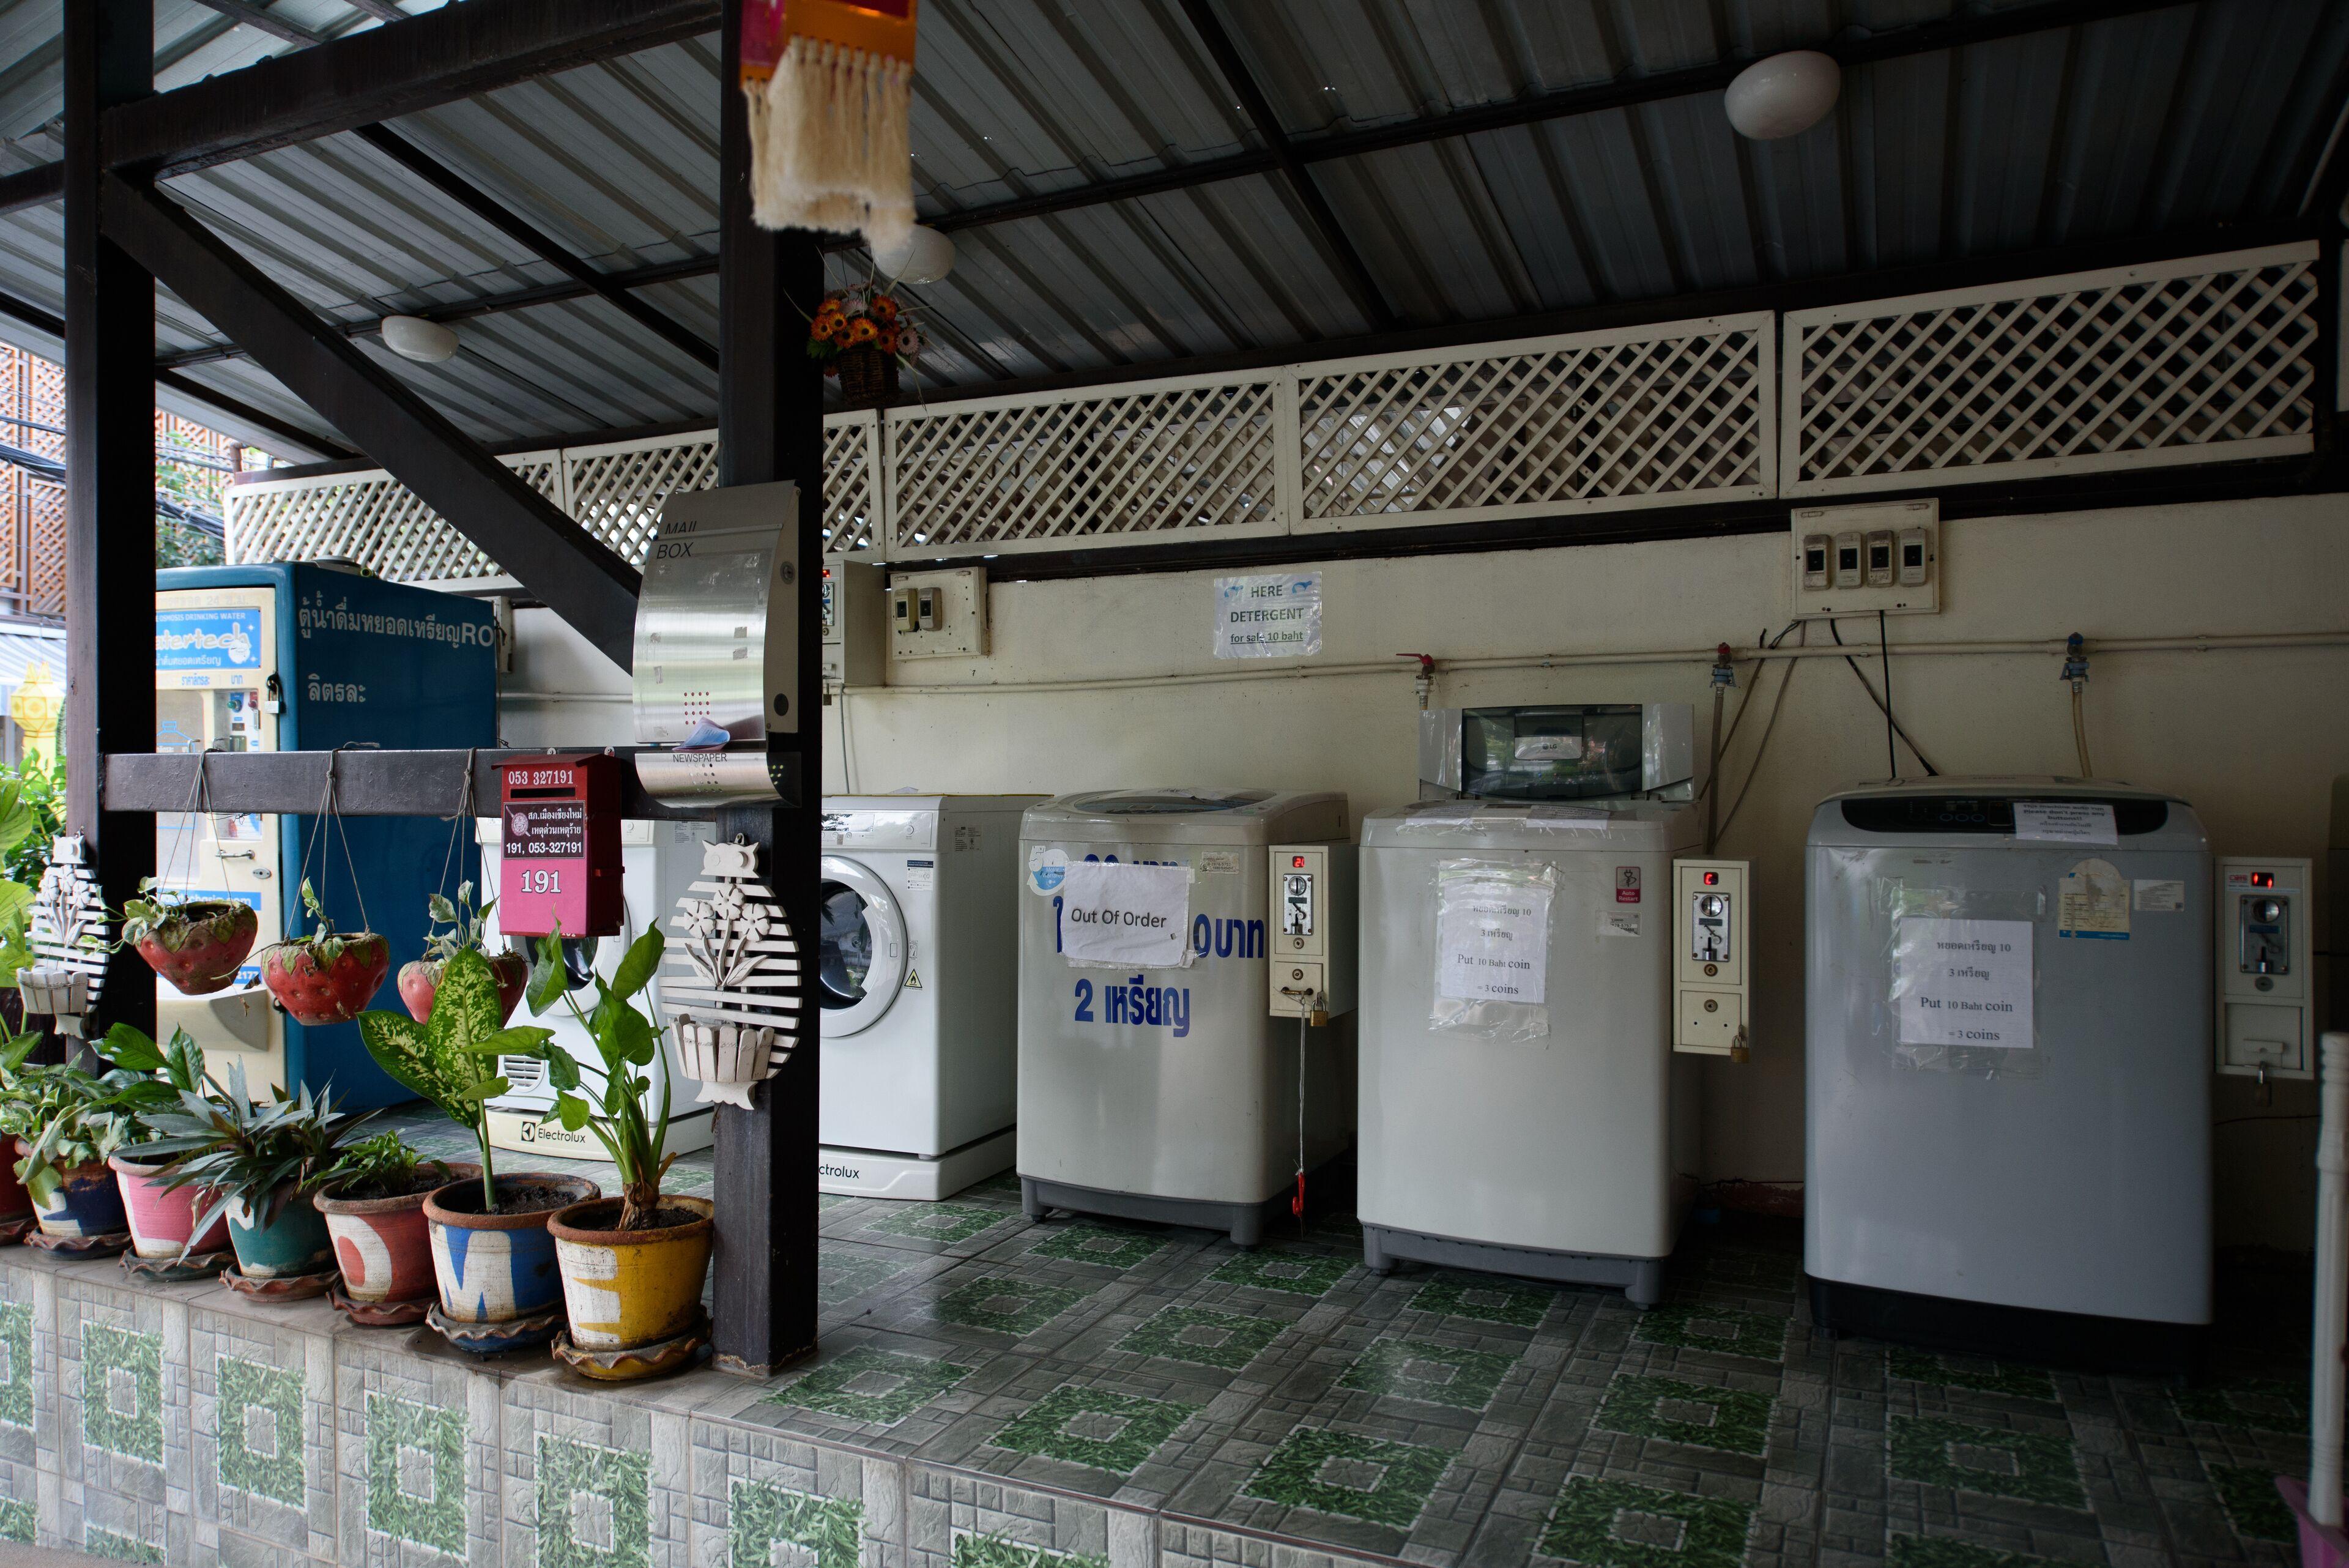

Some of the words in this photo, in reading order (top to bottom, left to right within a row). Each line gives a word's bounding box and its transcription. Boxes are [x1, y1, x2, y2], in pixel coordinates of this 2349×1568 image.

[656, 542, 694, 559] BOX
[1251, 585, 1283, 597] HERE
[1231, 608, 1304, 622] DETERGENT
[156, 622, 251, 650] atertech
[1231, 634, 1244, 643] for
[1268, 632, 1278, 641] 10
[1282, 631, 1303, 641] baht
[308, 674, 366, 702] ลิตรละ
[673, 753, 727, 762] NEWSPAPER
[508, 771, 529, 785] 053
[533, 770, 573, 786] 327191
[528, 808, 582, 821] สภ.เมืองเชียงใหม่
[532, 822, 581, 838] เหตุด่วนเหตุร้าย
[506, 842, 525, 855] 191,
[529, 842, 582, 854] 053-327191
[521, 869, 562, 894] 191
[1072, 908, 1098, 924] Out
[1102, 910, 1119, 925] Of
[1123, 912, 1167, 928] Order
[2000, 943, 2011, 952] 10
[1458, 954, 1473, 965] Put
[1508, 959, 1531, 970] coin
[1948, 968, 1954, 977] 3
[1958, 966, 1990, 981] เหรียญ
[1491, 984, 1519, 994] coins
[1075, 979, 1094, 1022] 2
[1105, 975, 1190, 1038] เหรียญ
[1920, 997, 1942, 1009] Put
[1948, 1001, 1958, 1009] 10
[1961, 1001, 1982, 1010] Baht
[1985, 1000, 2013, 1012] coin
[1966, 1029, 2000, 1040] coins
[538, 1128, 585, 1143] Electrolux
[818, 1164, 859, 1179] ctrolux
